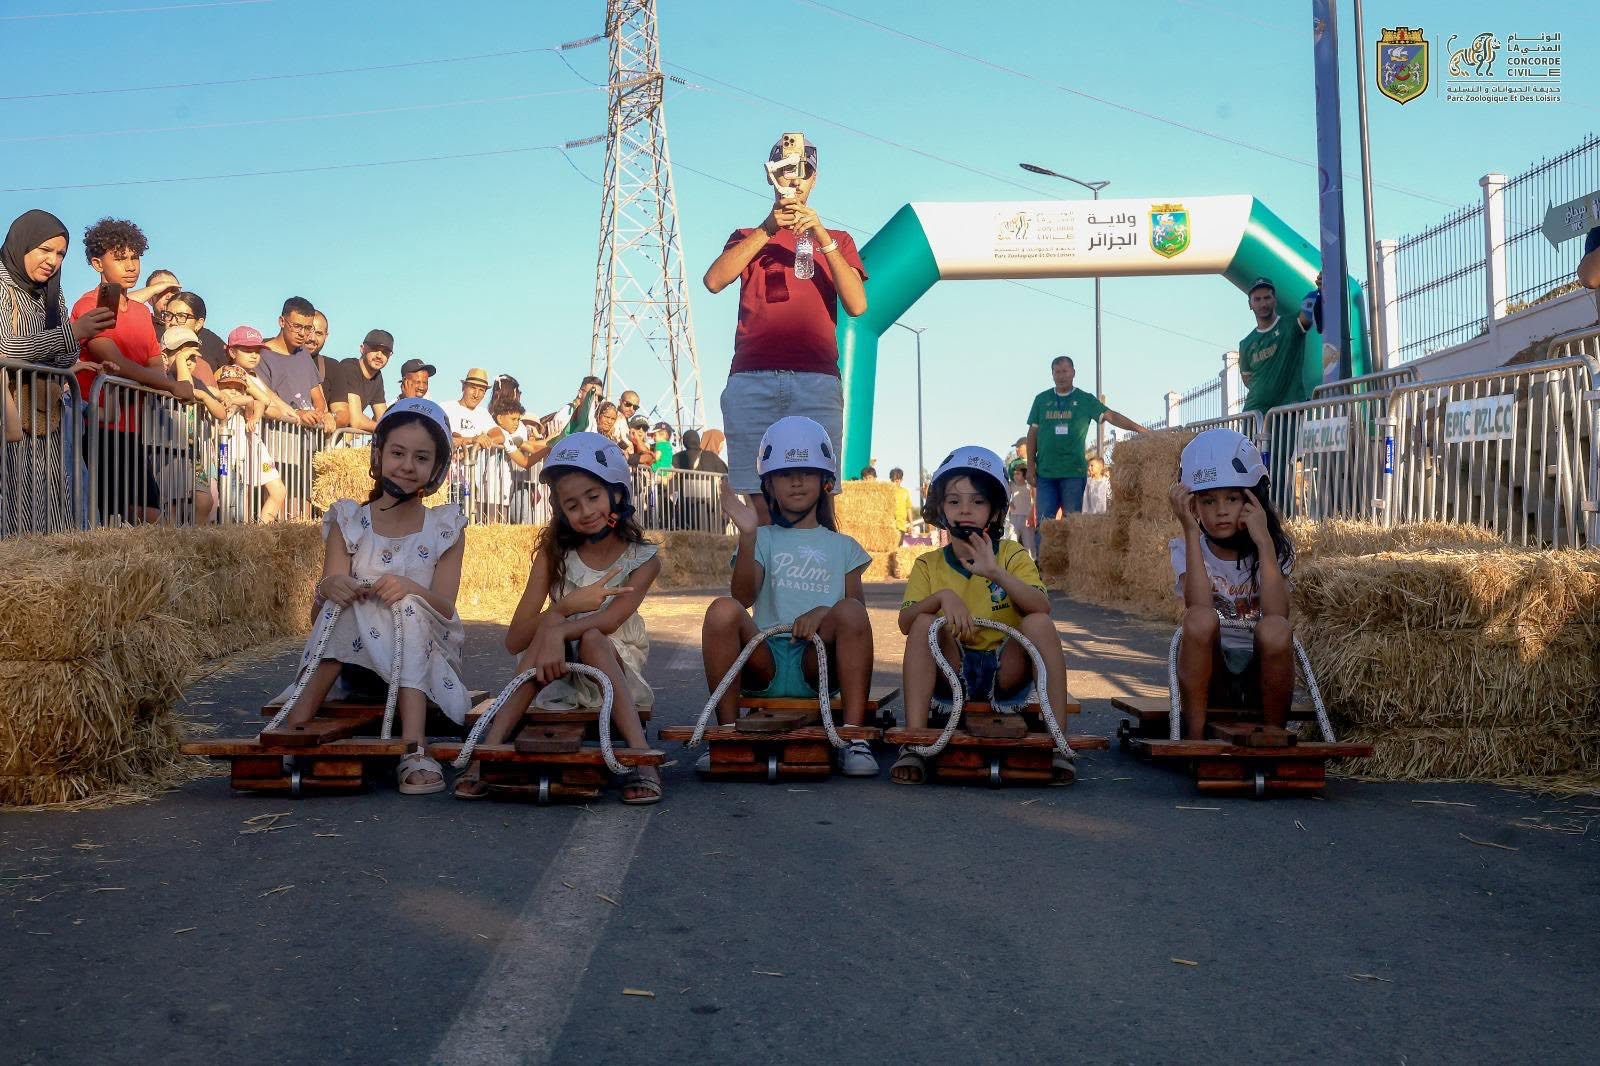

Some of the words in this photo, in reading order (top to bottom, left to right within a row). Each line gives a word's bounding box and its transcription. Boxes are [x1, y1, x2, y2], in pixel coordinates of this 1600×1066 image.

[1087, 211, 1136, 228] ولاية
[1087, 231, 1137, 251] الجزائر
[1445, 410, 1471, 437] EPIC
[1473, 404, 1511, 435] PZLCC
[770, 552, 832, 581] Palm
[771, 578, 831, 594] PARADISE
